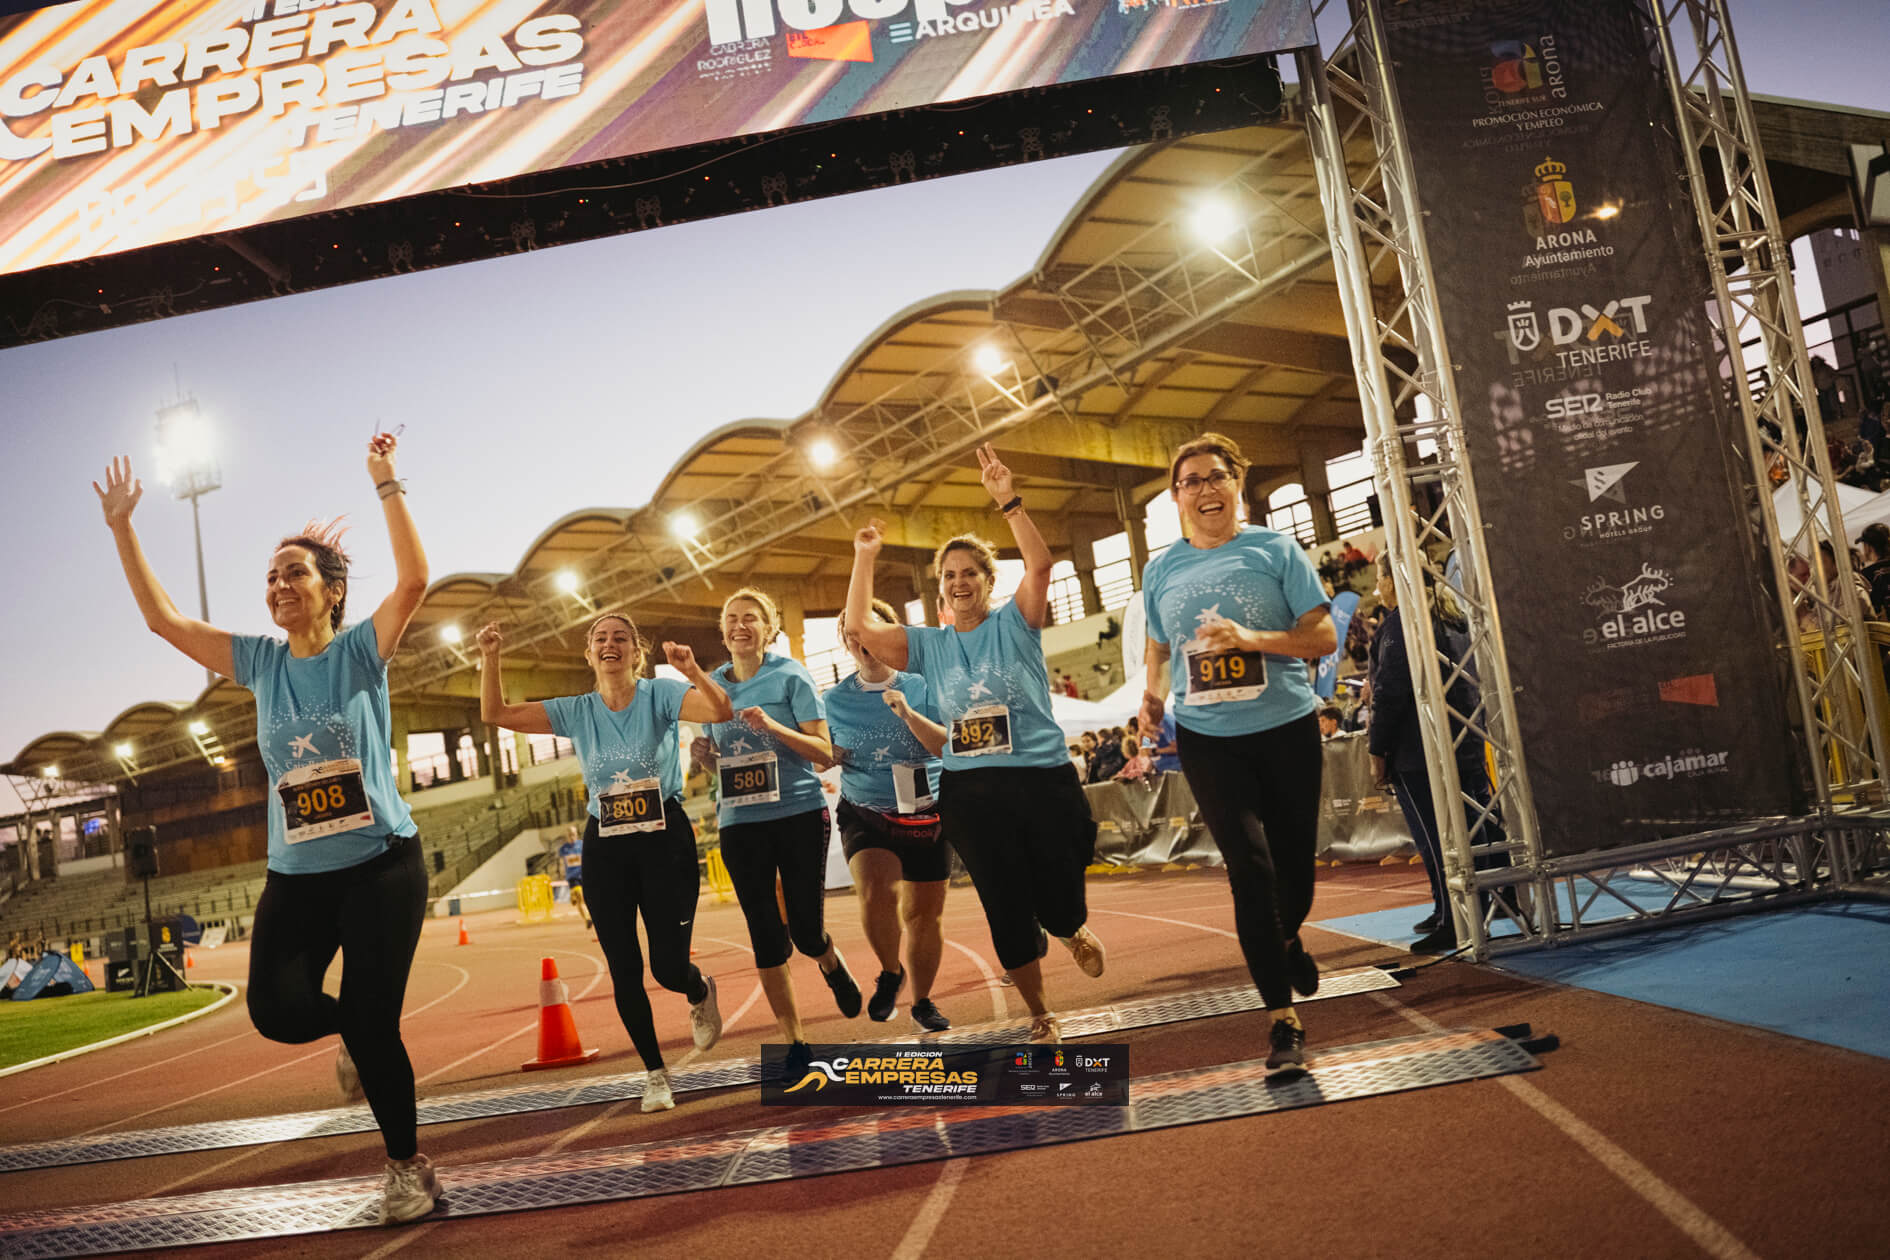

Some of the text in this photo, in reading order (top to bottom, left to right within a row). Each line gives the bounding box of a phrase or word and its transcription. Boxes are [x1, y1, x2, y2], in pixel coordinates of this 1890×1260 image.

[0, 0, 442, 117] CARRERA
[51, 14, 584, 160] EMPRESAS
[292, 63, 584, 148] TENERIFE
[1516, 117, 1564, 131] Y EMPLEO
[1536, 229, 1598, 250] ARONA
[1524, 244, 1614, 269] Ayuntamiento
[1549, 295, 1652, 345] DXT
[1556, 339, 1653, 369] TENERIFE
[1545, 393, 1603, 419] SER
[1605, 388, 1653, 401] Radio Club
[1607, 398, 1641, 409] Tenerife
[1581, 504, 1665, 531] SPRING
[1601, 609, 1686, 639] el alce
[1199, 655, 1246, 683] 919
[960, 722, 994, 745] 892
[733, 769, 766, 790] 580
[1643, 751, 1729, 781] cajamar
[297, 784, 346, 816] 908
